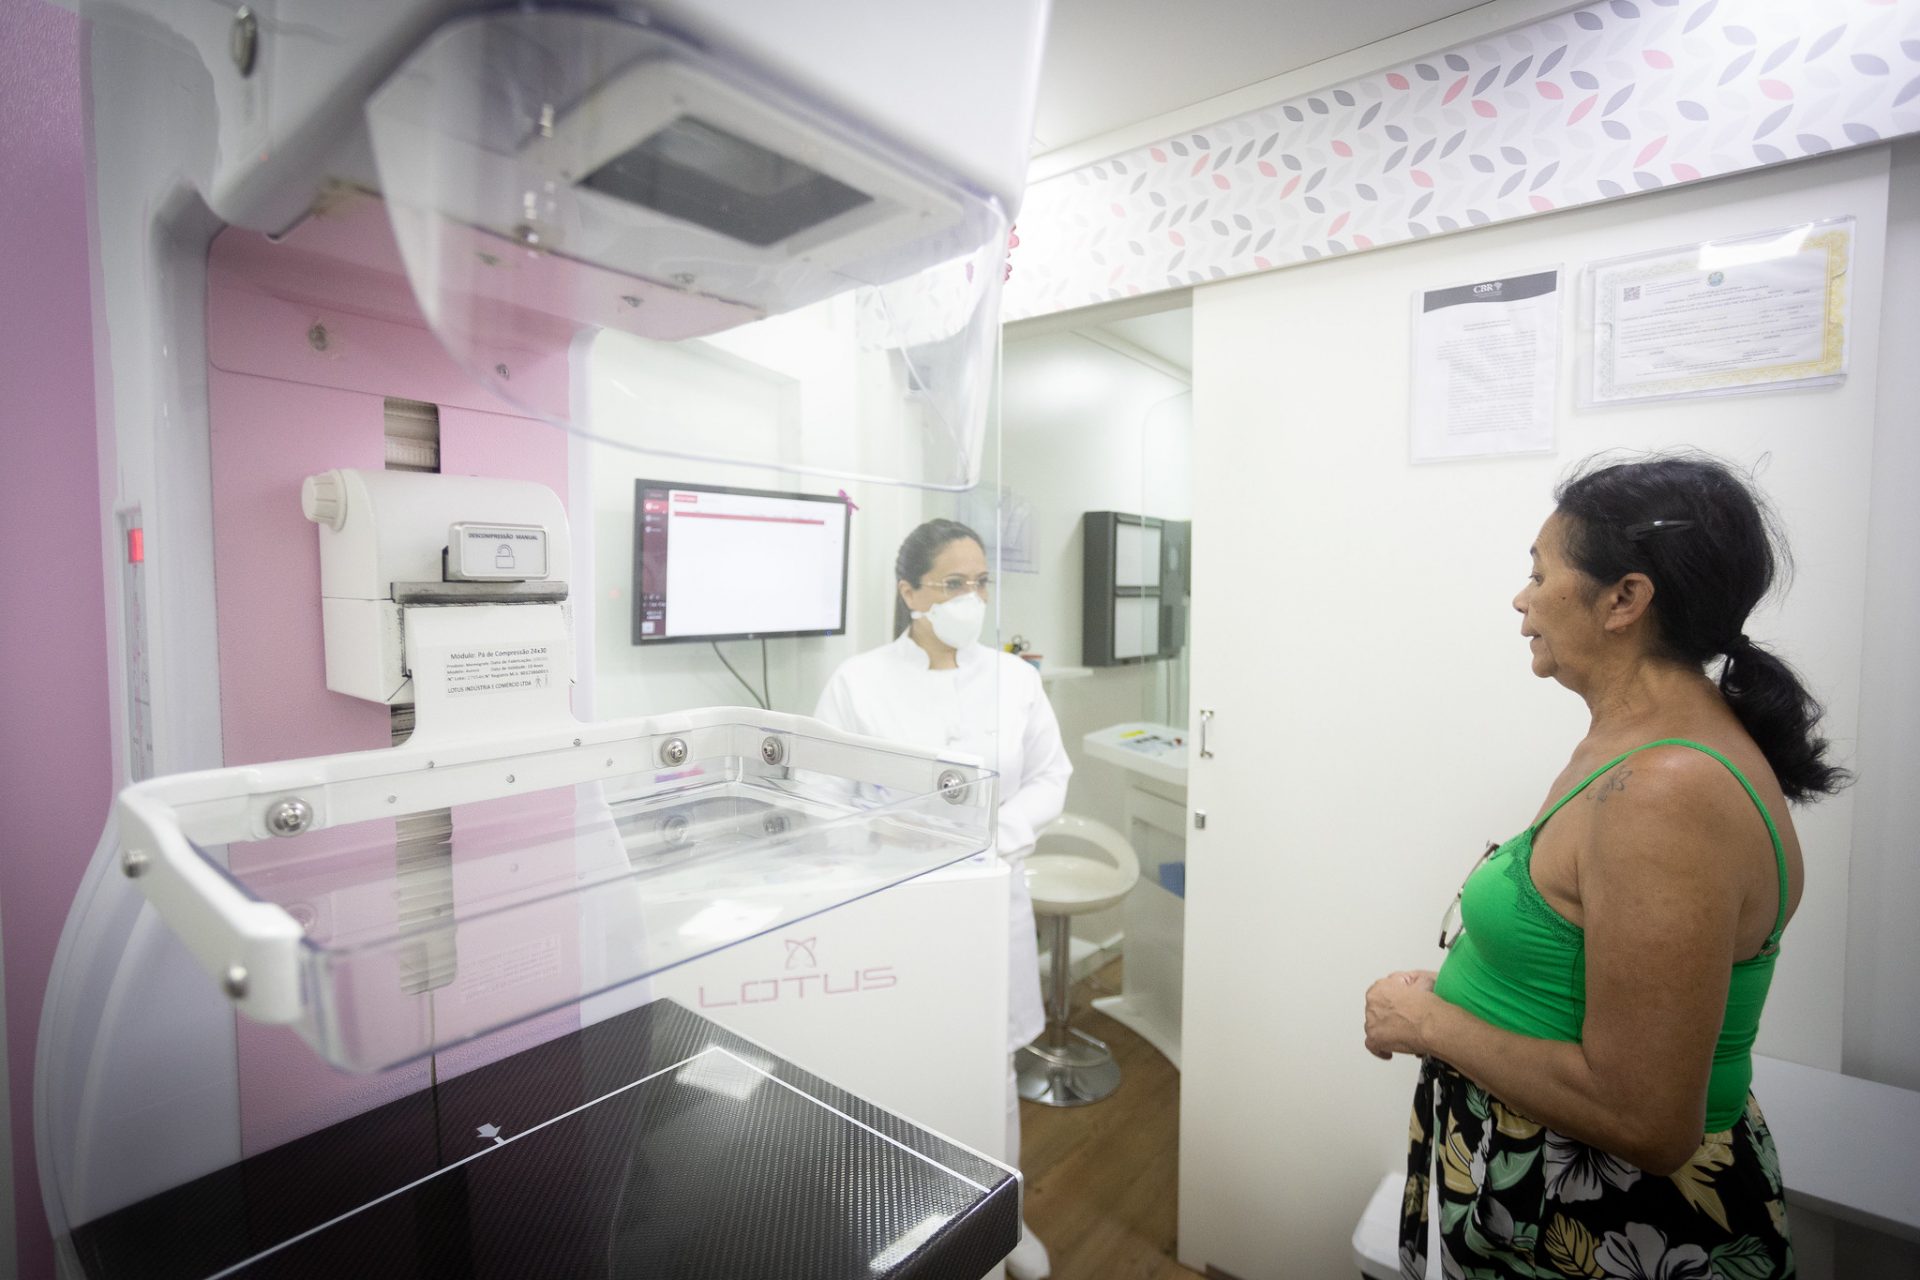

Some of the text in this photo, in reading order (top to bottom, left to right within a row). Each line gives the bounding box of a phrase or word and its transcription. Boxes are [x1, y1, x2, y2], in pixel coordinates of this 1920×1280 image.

[1473, 281, 1494, 294] CBR
[486, 650, 494, 658] de
[495, 648, 529, 657] Compressão
[530, 647, 547, 655] 24x30
[448, 686, 464, 694] LOTUS
[699, 967, 897, 1007] LOTUS
